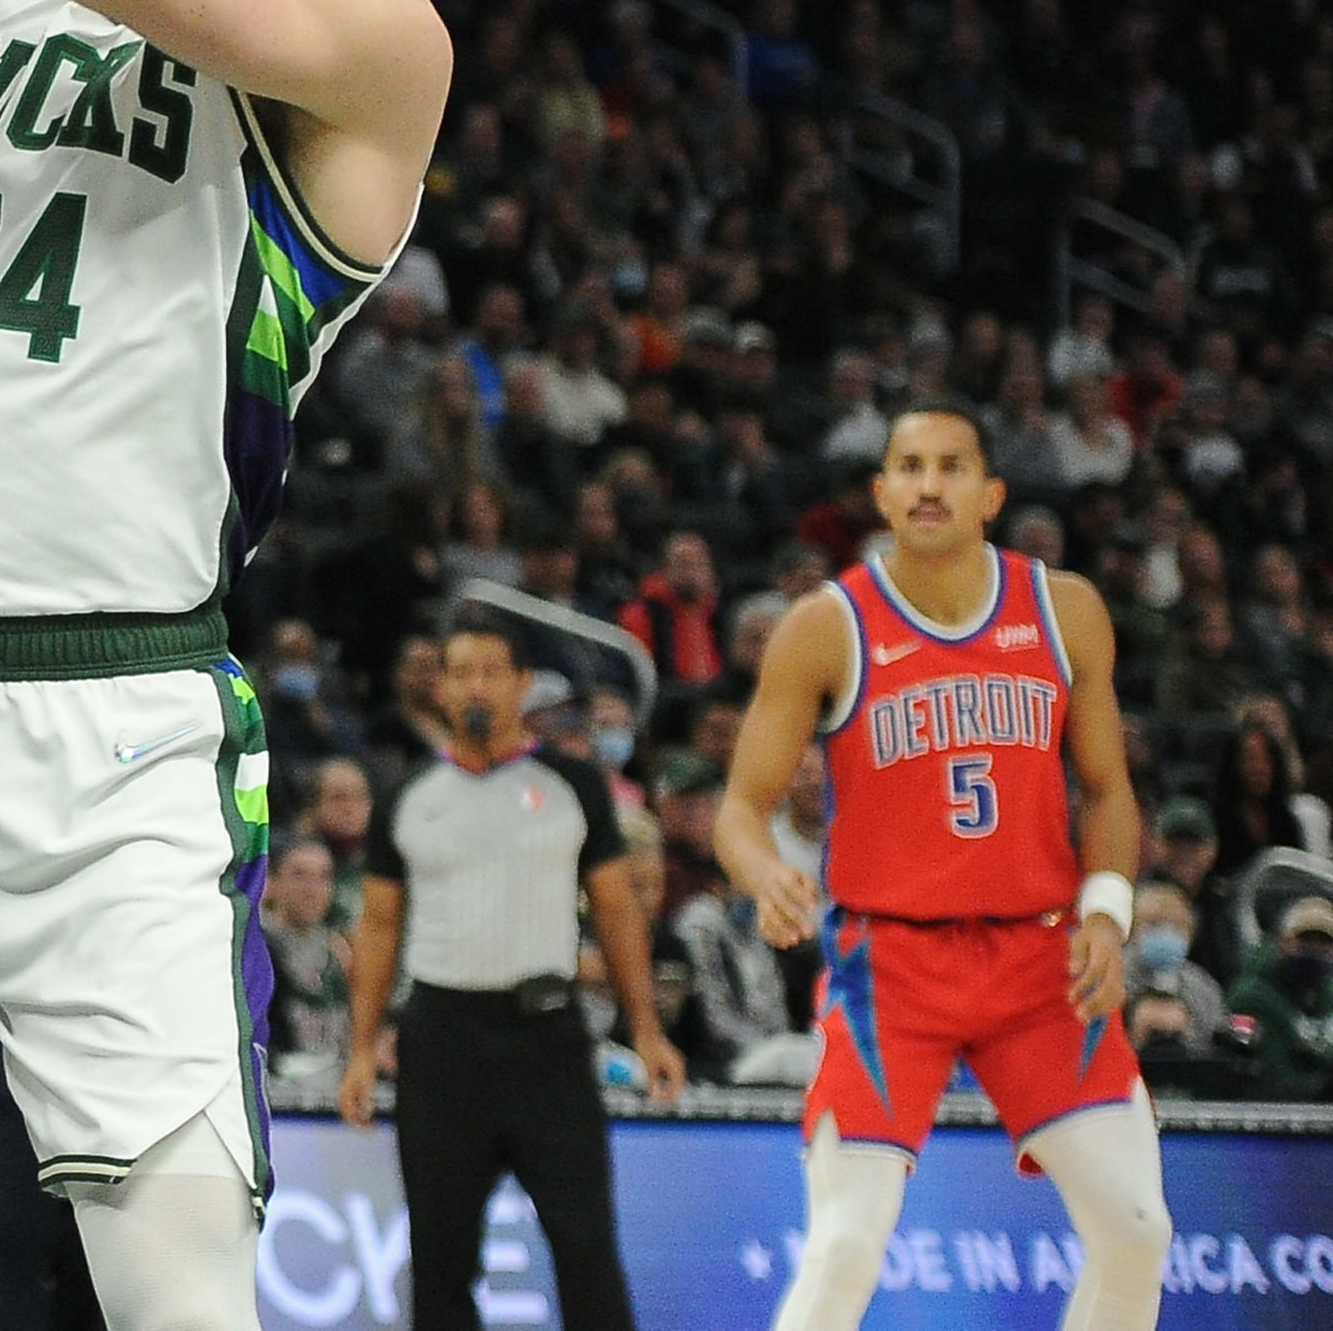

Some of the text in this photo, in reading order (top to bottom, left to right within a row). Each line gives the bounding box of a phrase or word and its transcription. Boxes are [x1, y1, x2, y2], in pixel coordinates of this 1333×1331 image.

[868, 672, 1057, 770] DETROIT
[945, 751, 1000, 839] 5
[954, 1229, 1021, 1293] IN
